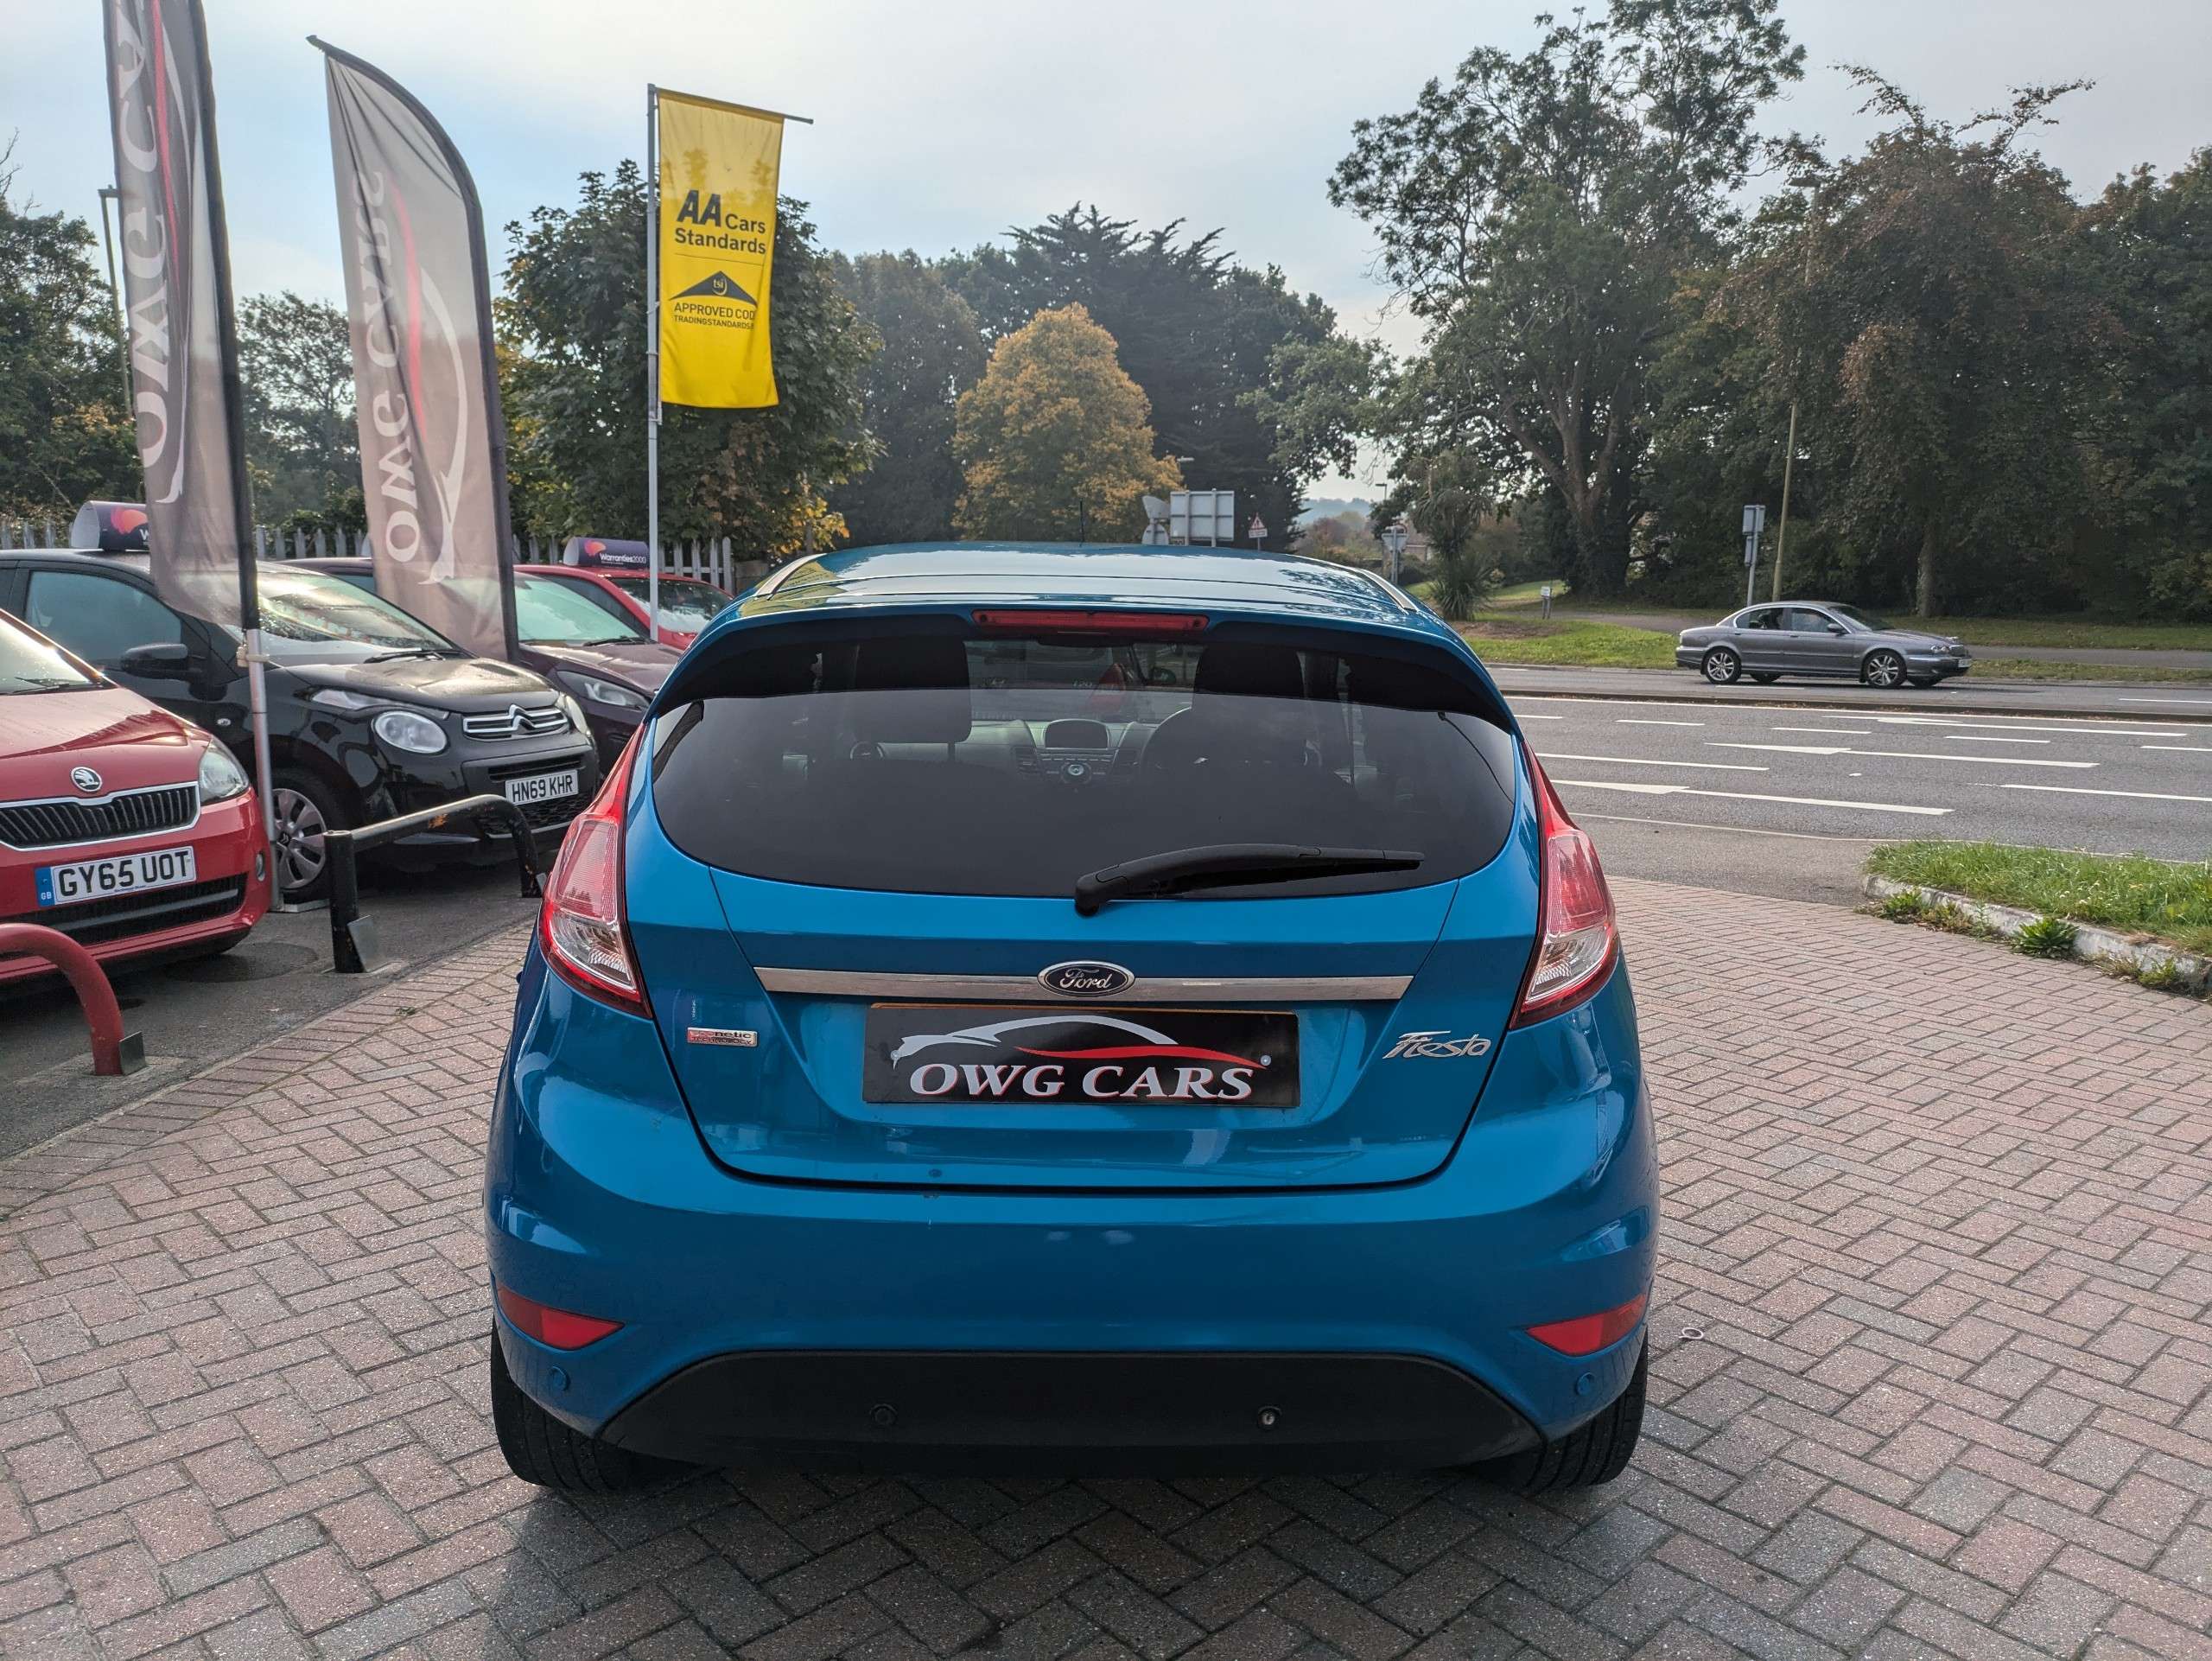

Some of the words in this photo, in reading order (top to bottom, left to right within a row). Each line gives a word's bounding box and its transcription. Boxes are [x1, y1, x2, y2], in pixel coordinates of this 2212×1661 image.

[677, 189, 721, 227] AA
[725, 213, 766, 234] Cars
[675, 227, 766, 254] Standards
[674, 302, 734, 318] APPROVED
[735, 309, 755, 321] COD
[512, 780, 546, 802] HN69
[549, 775, 573, 795] KHR
[59, 859, 134, 897] GY65
[141, 850, 188, 883] UOT
[1059, 968, 1113, 989] Ford
[1382, 1030, 1491, 1060] Fiesta
[910, 1063, 1065, 1096] OWG
[1082, 1066, 1254, 1100] CARS
